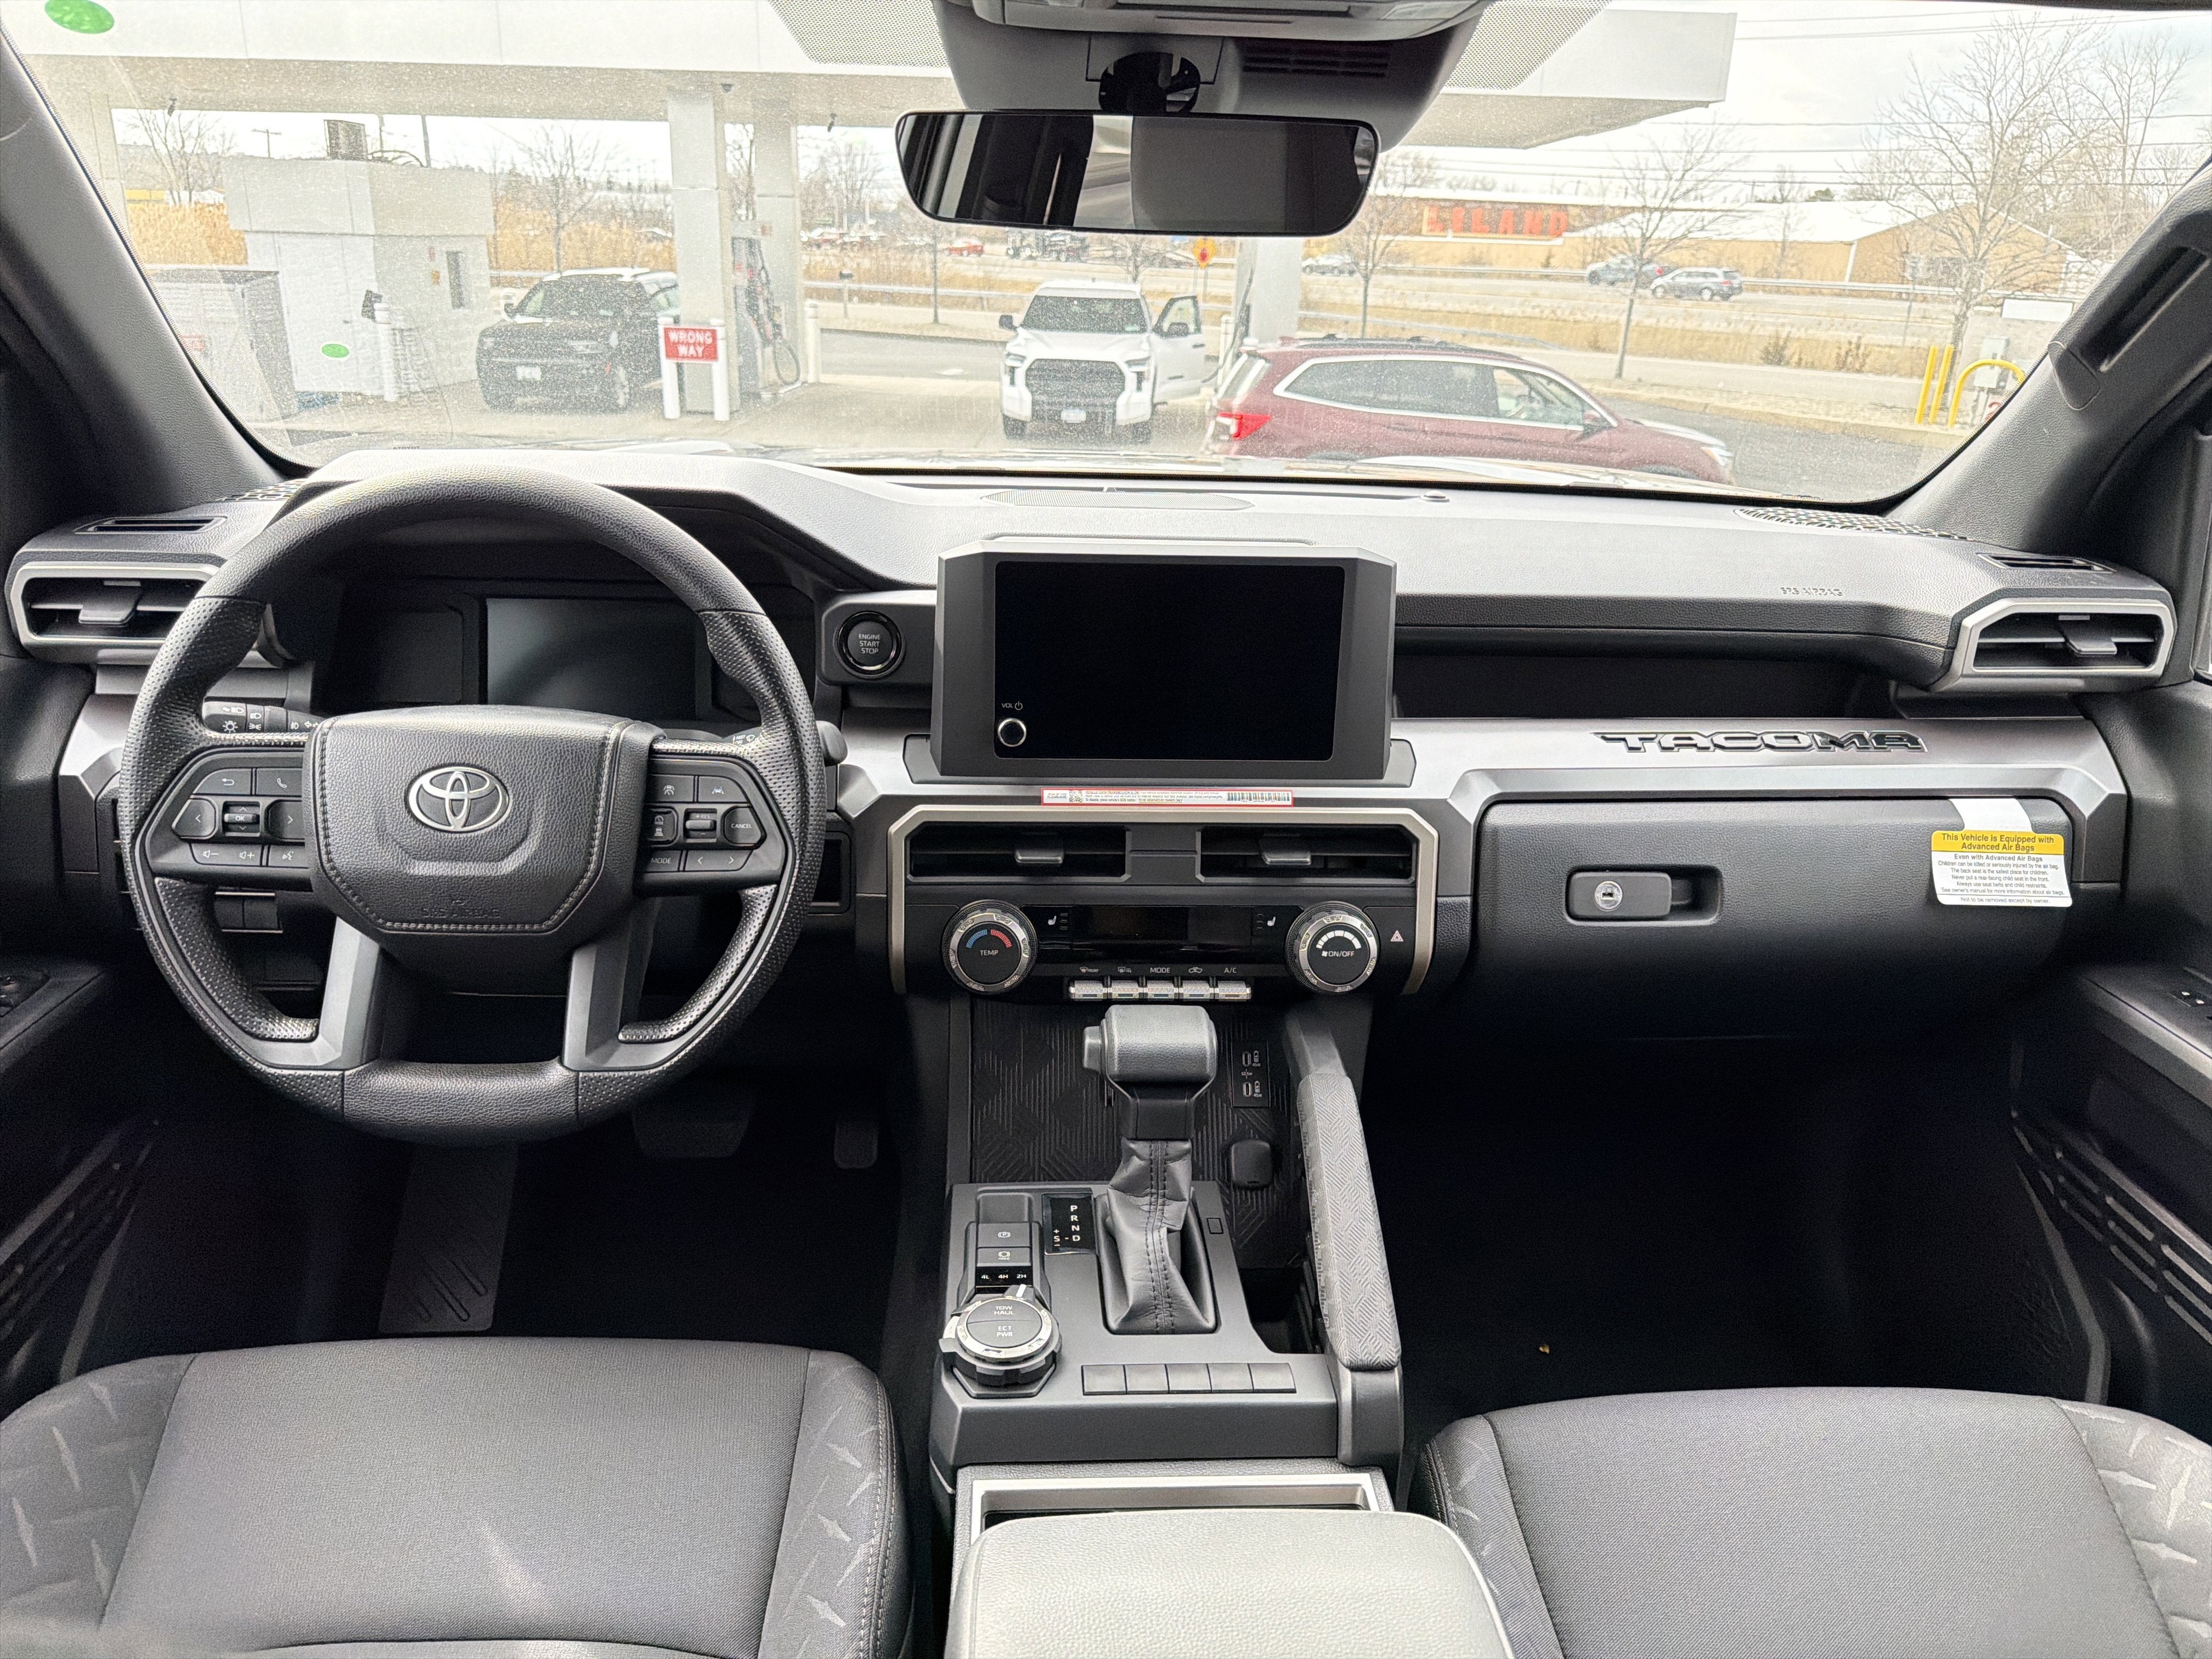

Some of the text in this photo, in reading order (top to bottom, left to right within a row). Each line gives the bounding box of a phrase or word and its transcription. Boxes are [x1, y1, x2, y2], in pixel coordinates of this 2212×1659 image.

[668, 330, 713, 345] WRONG
[676, 343, 705, 358] WAY
[1590, 731, 1928, 752] TACOMA
[2000, 835, 2036, 844] Equipped
[2015, 844, 2035, 853] Bags
